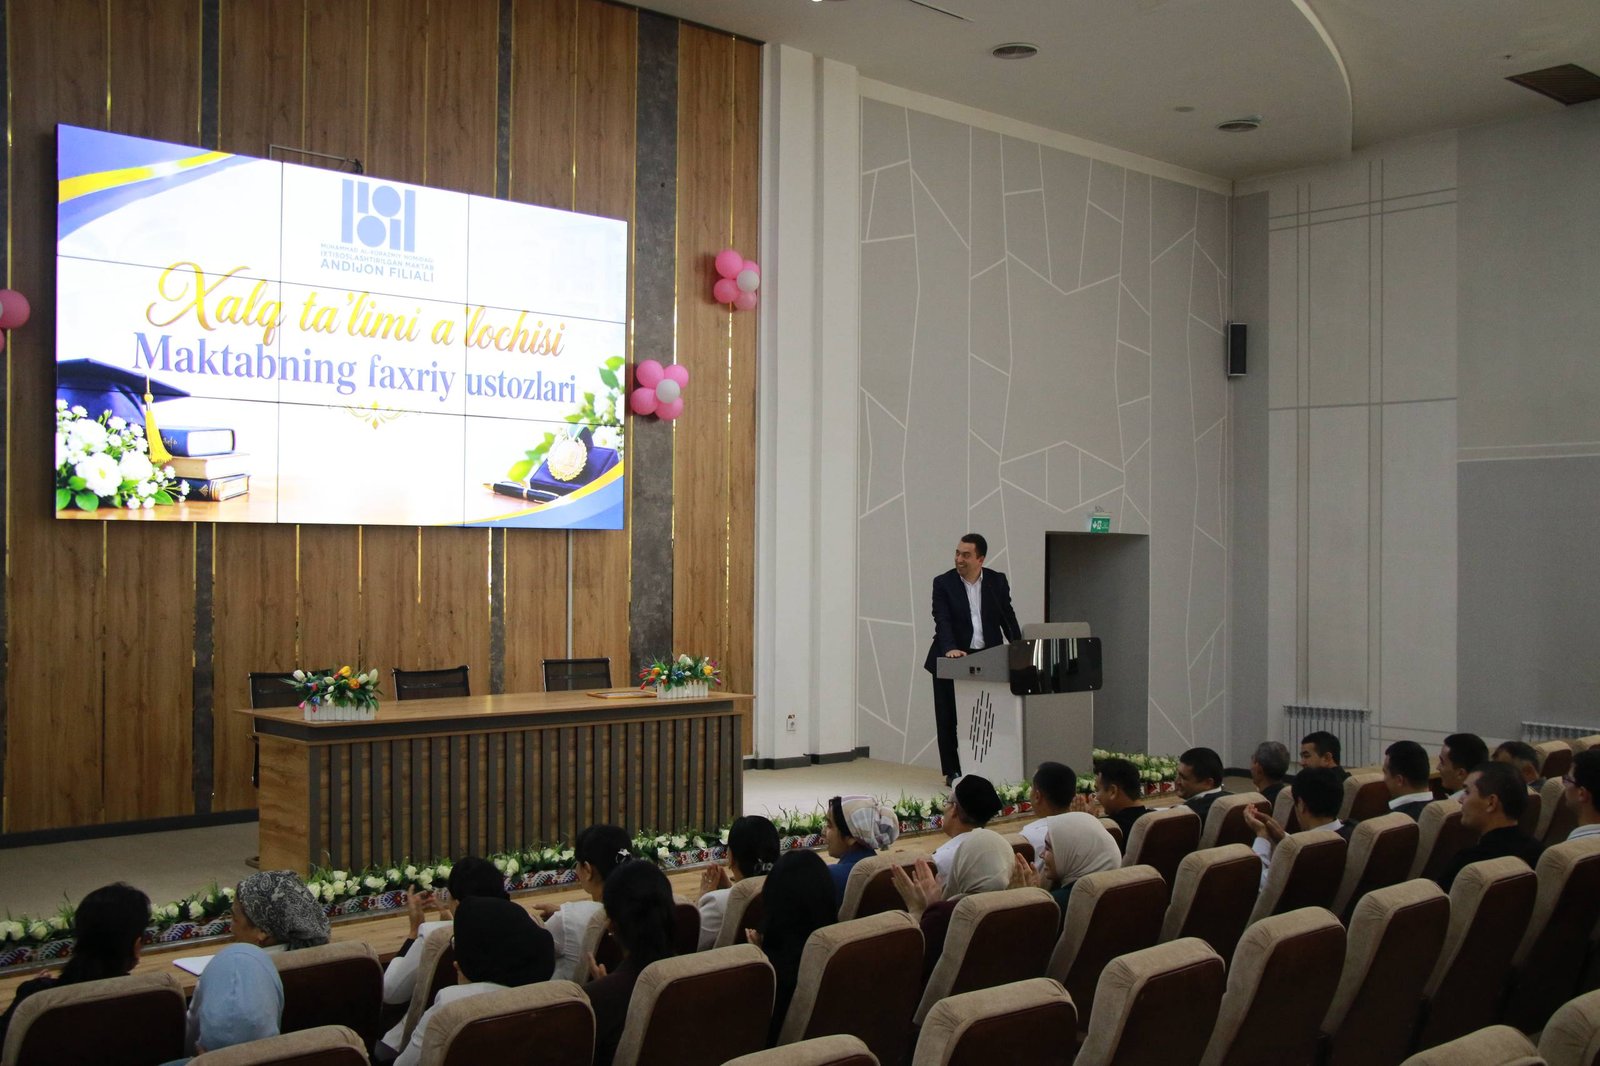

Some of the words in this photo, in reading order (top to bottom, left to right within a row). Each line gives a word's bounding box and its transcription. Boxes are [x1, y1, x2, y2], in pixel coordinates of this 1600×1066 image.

[146, 261, 287, 346] Xalq
[320, 258, 384, 276] ANDIJON
[389, 267, 434, 282] FILIALI
[132, 332, 357, 395] Maktabning
[368, 354, 456, 402] faxriy
[466, 370, 576, 404] ustozlari
